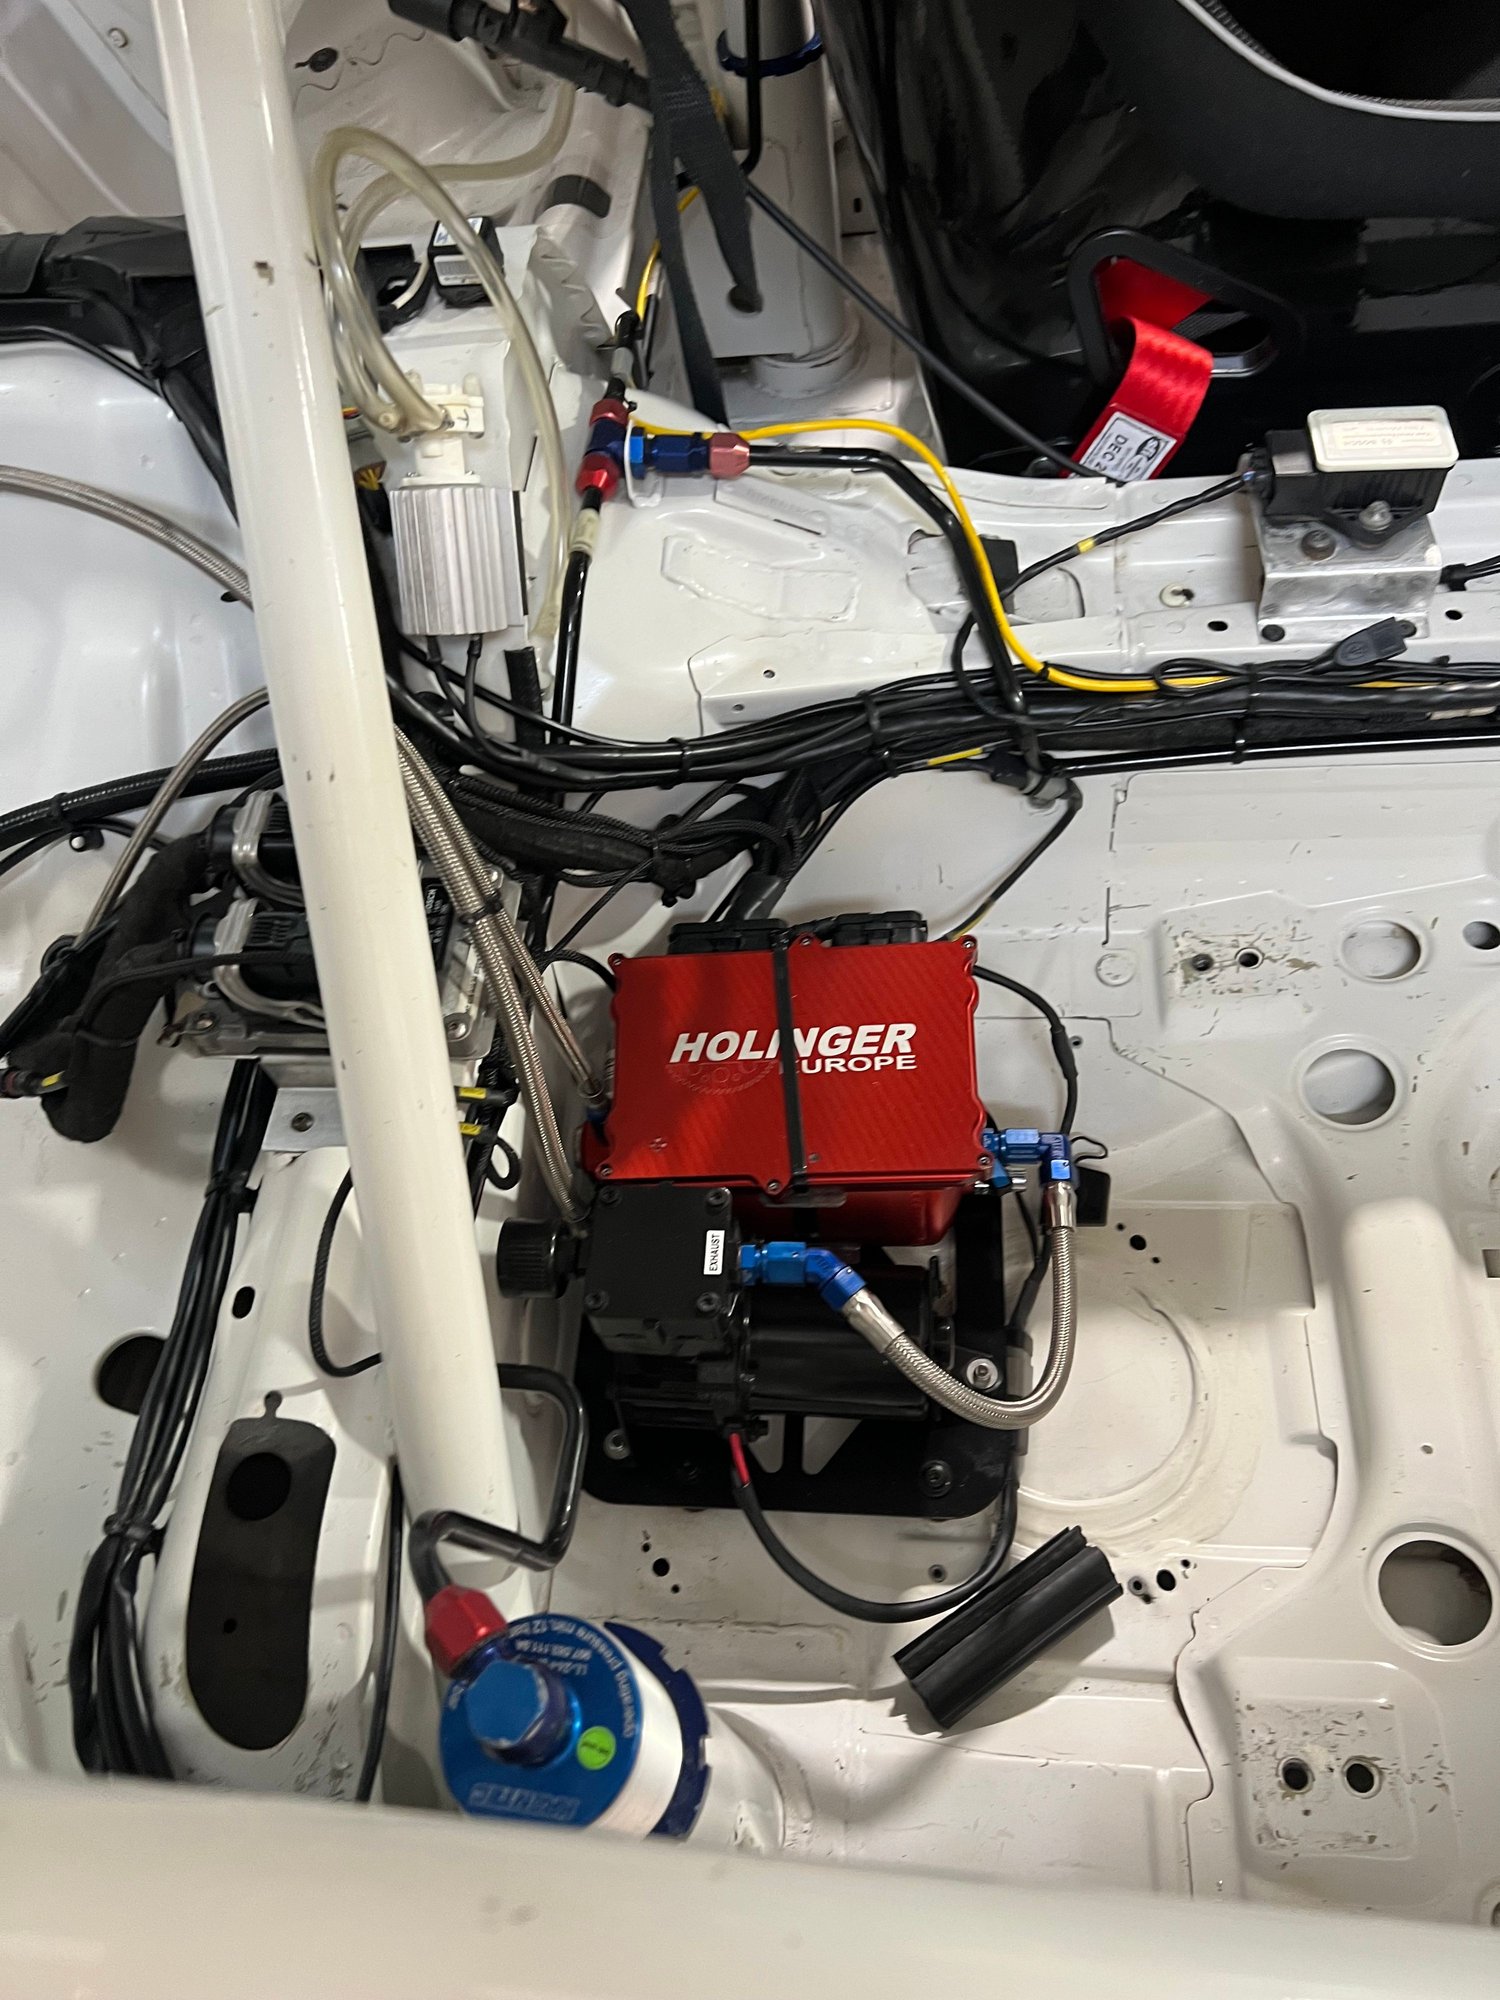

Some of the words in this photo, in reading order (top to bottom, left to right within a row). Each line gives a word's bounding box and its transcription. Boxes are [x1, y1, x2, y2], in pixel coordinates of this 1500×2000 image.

[1101, 434, 1129, 462] DEC
[669, 1023, 917, 1064] HOLINGER
[780, 1054, 918, 1075] UROPE
[709, 1233, 720, 1272] EXHAUST
[532, 1618, 549, 1634] 12
